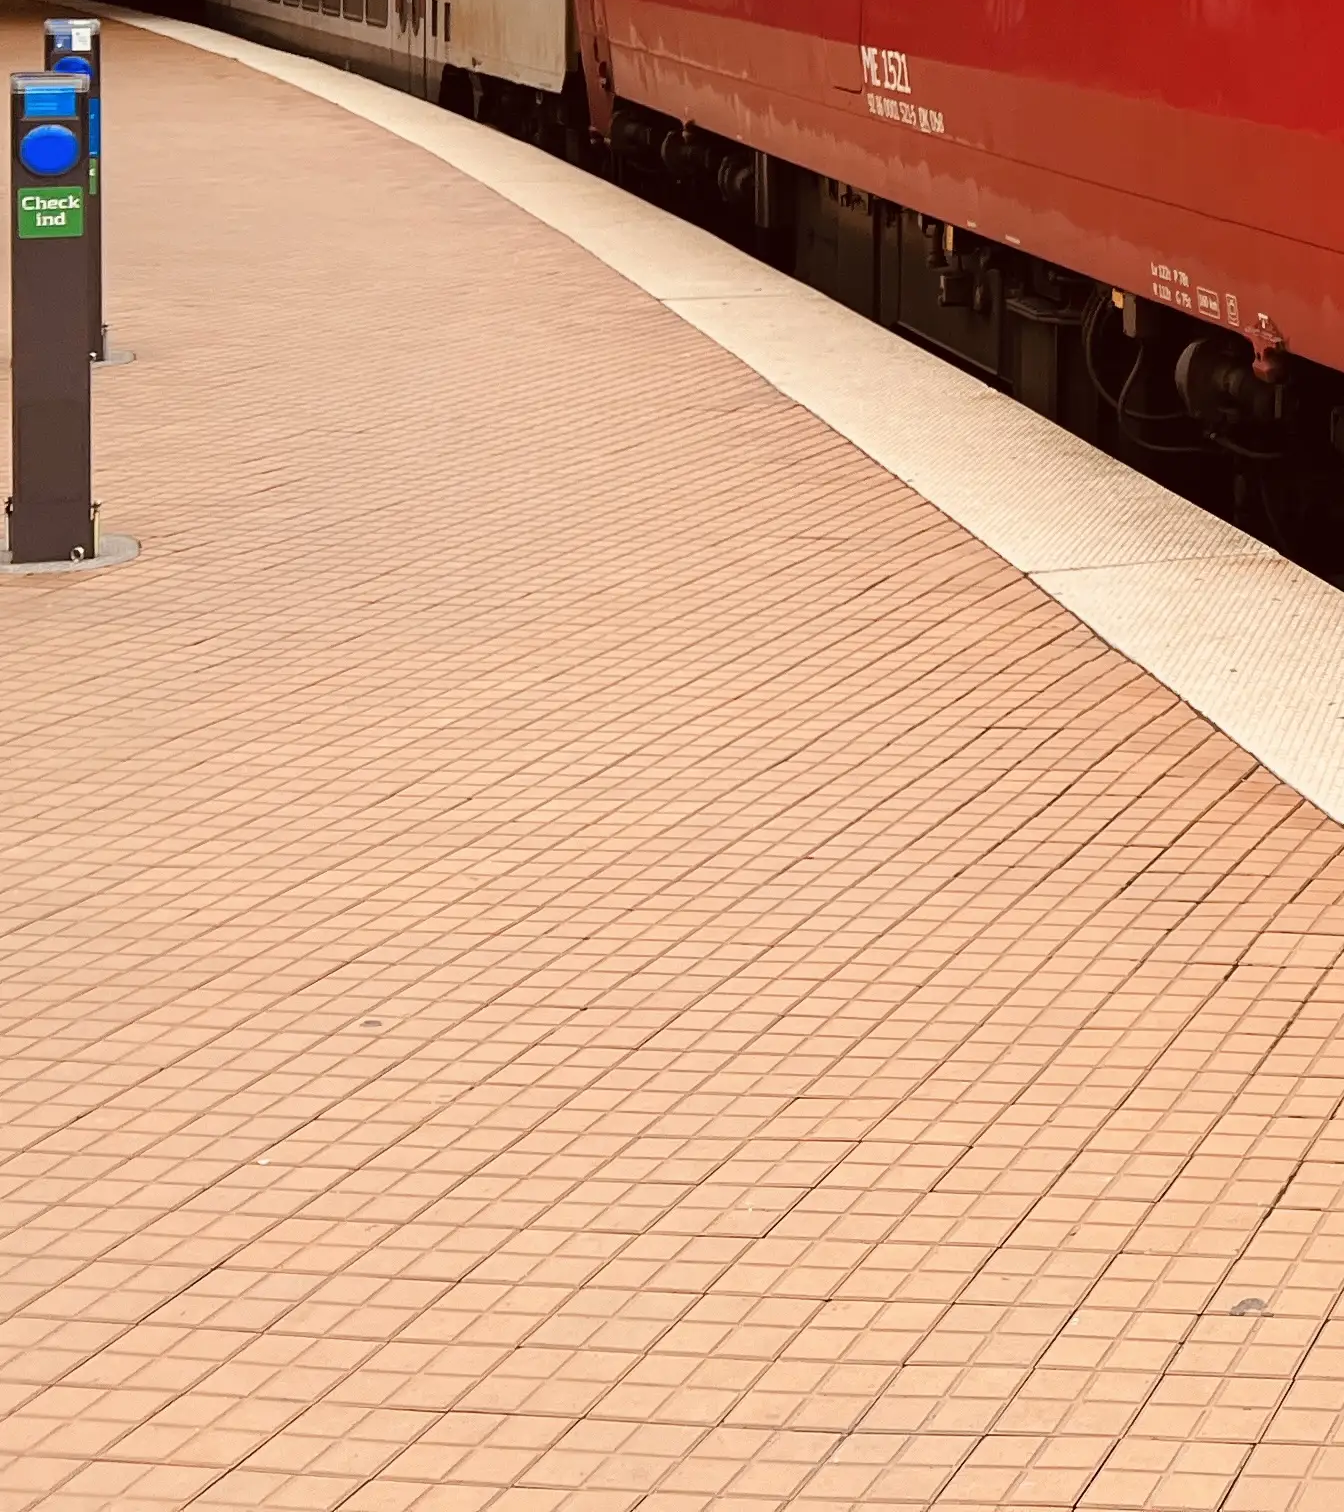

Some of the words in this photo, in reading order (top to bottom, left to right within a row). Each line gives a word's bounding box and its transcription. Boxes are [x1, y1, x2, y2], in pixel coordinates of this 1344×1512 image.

[861, 45, 881, 87] ME
[881, 49, 911, 94] 1521
[21, 195, 80, 211] Check
[36, 211, 66, 227] ind
